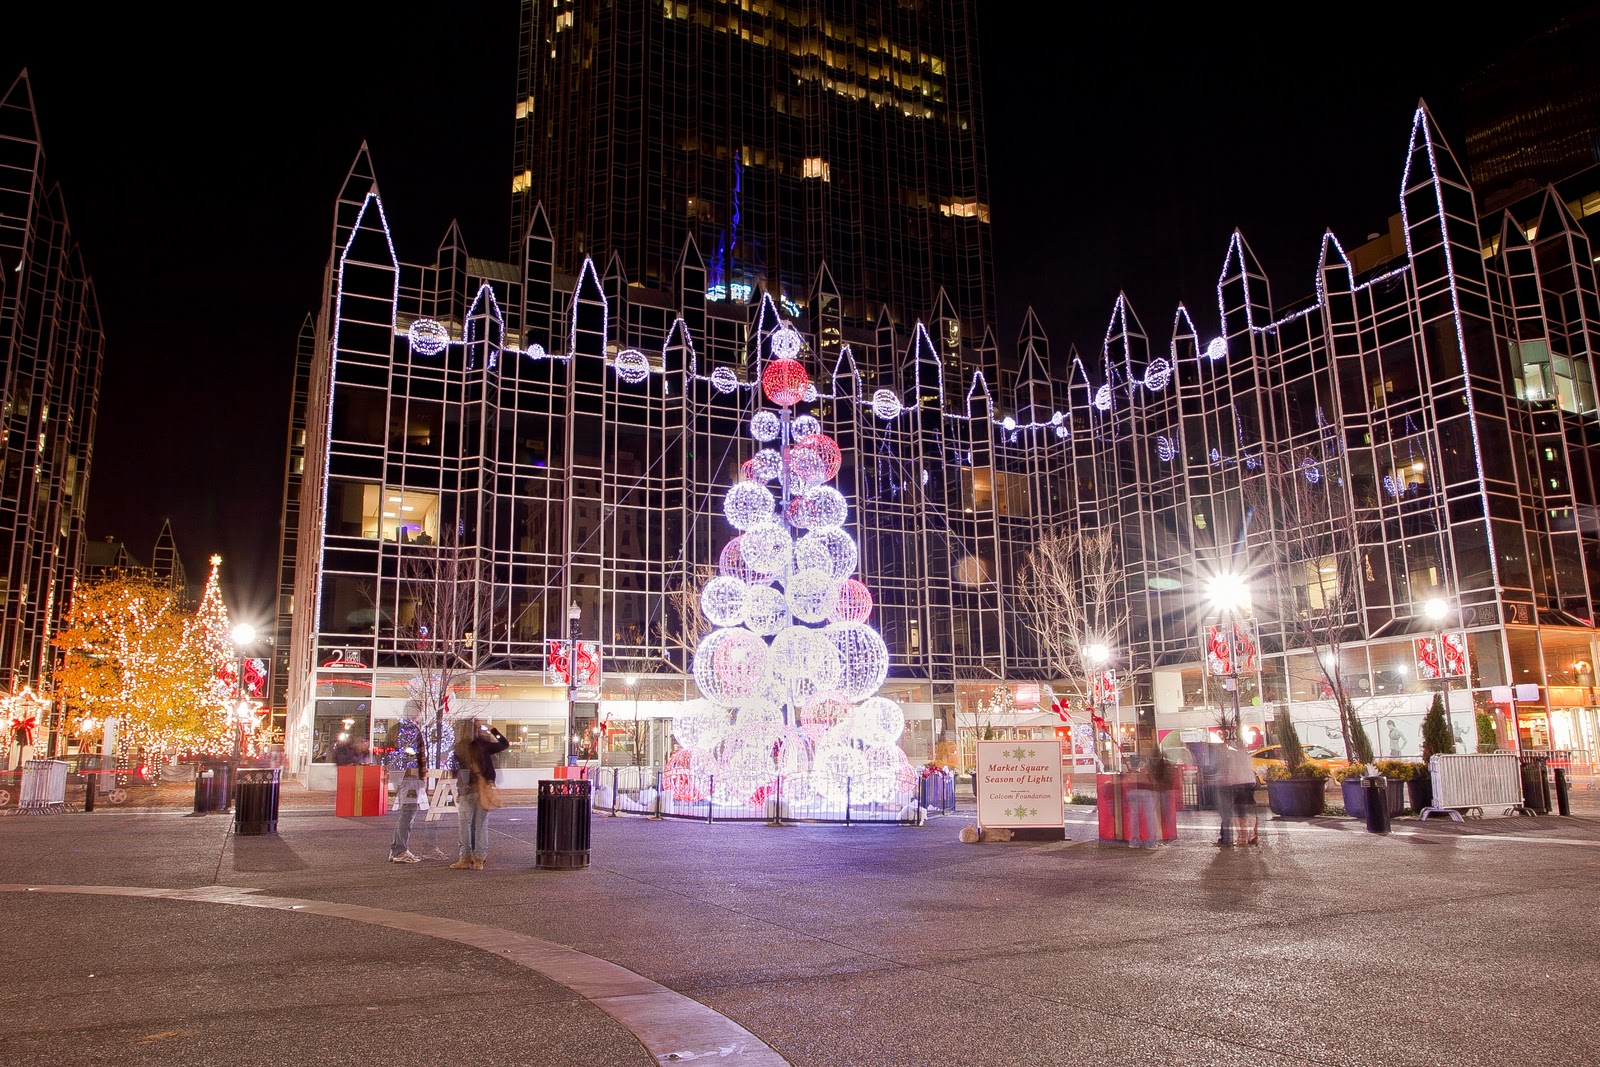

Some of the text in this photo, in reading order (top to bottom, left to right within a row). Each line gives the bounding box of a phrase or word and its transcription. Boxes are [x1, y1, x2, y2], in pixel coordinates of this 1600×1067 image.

[1465, 607, 1480, 627] 2
[1509, 604, 1520, 624] 2
[331, 649, 344, 668] 2
[988, 763, 1050, 773] Market Square
[985, 774, 1053, 785] Season of Lights
[1015, 792, 1052, 800] Foundation
